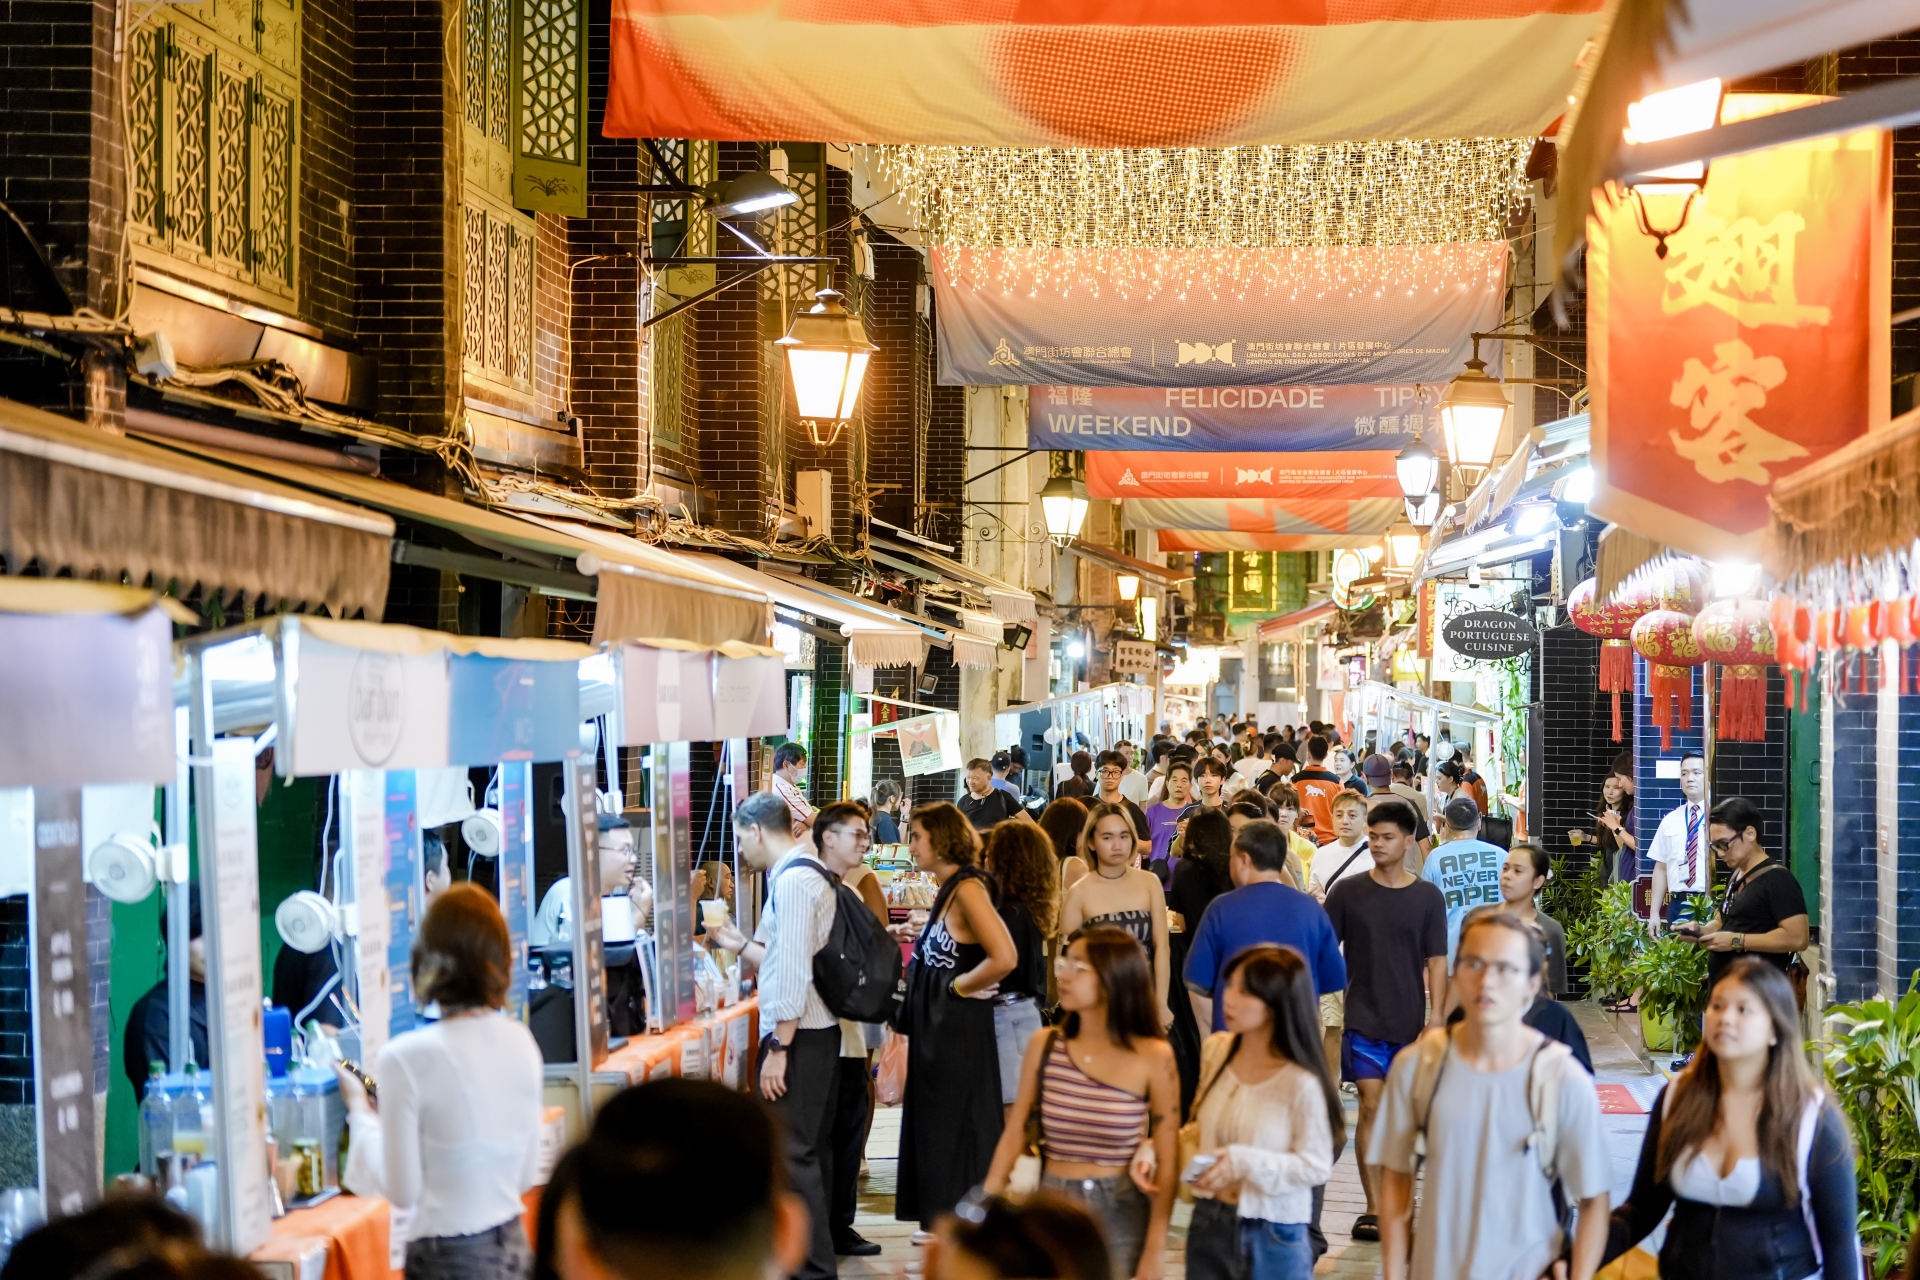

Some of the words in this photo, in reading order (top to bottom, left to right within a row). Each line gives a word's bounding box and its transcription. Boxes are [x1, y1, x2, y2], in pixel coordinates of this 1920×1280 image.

[1048, 387, 1093, 406] 福隆
[1165, 387, 1325, 408] FELICIDADE
[1374, 385, 1449, 408] TIPSY
[1047, 413, 1192, 437] WEEKEND
[1464, 619, 1516, 629] DRAGON
[1450, 631, 1530, 641] PORTUGUESE
[1464, 643, 1514, 652] CUISINE
[1440, 851, 1497, 875] APE
[1442, 870, 1498, 888] NEVER
[1445, 884, 1499, 909] APE
